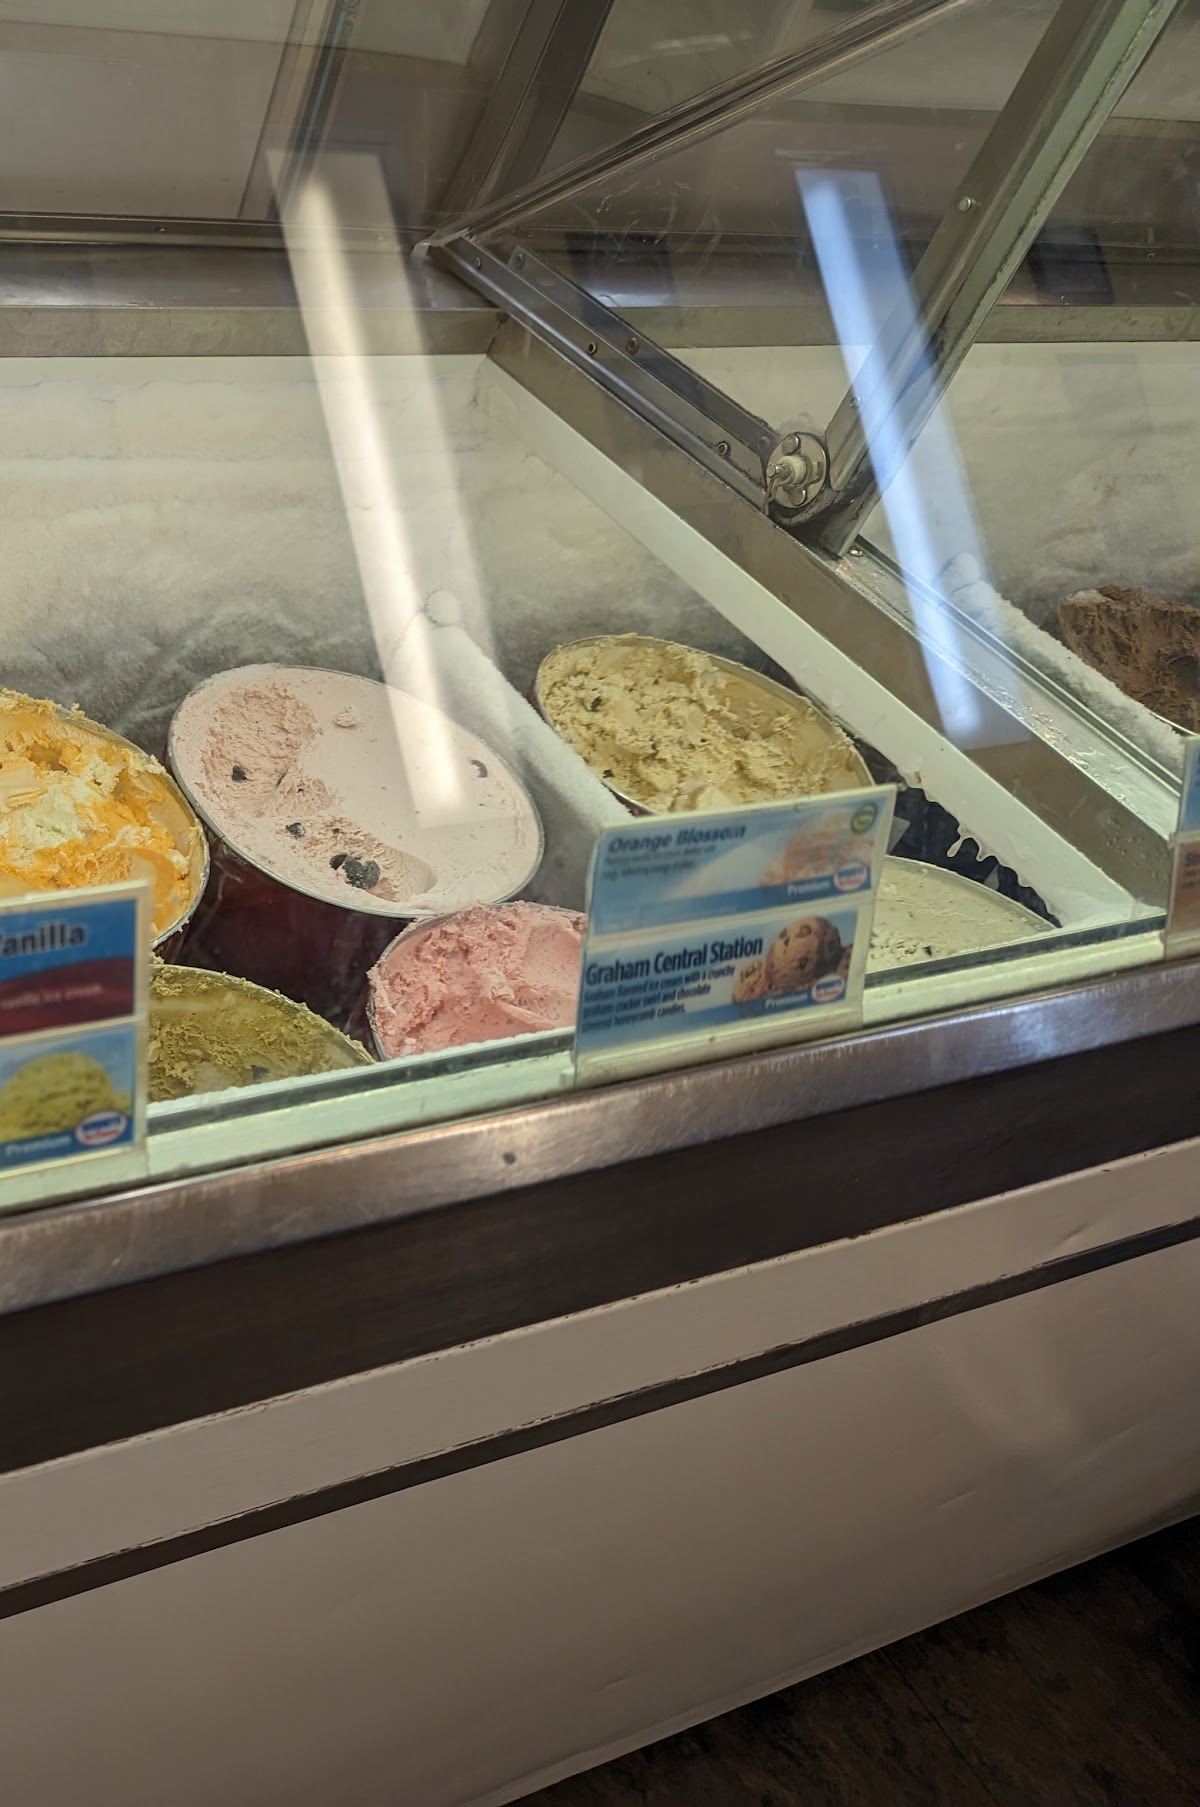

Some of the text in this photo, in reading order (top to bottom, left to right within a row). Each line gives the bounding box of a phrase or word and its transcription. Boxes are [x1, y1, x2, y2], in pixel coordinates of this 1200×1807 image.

[608, 824, 747, 854] Orange Blossom
[586, 936, 763, 986] Graham Central Station
[676, 983, 712, 1000] chocolate
